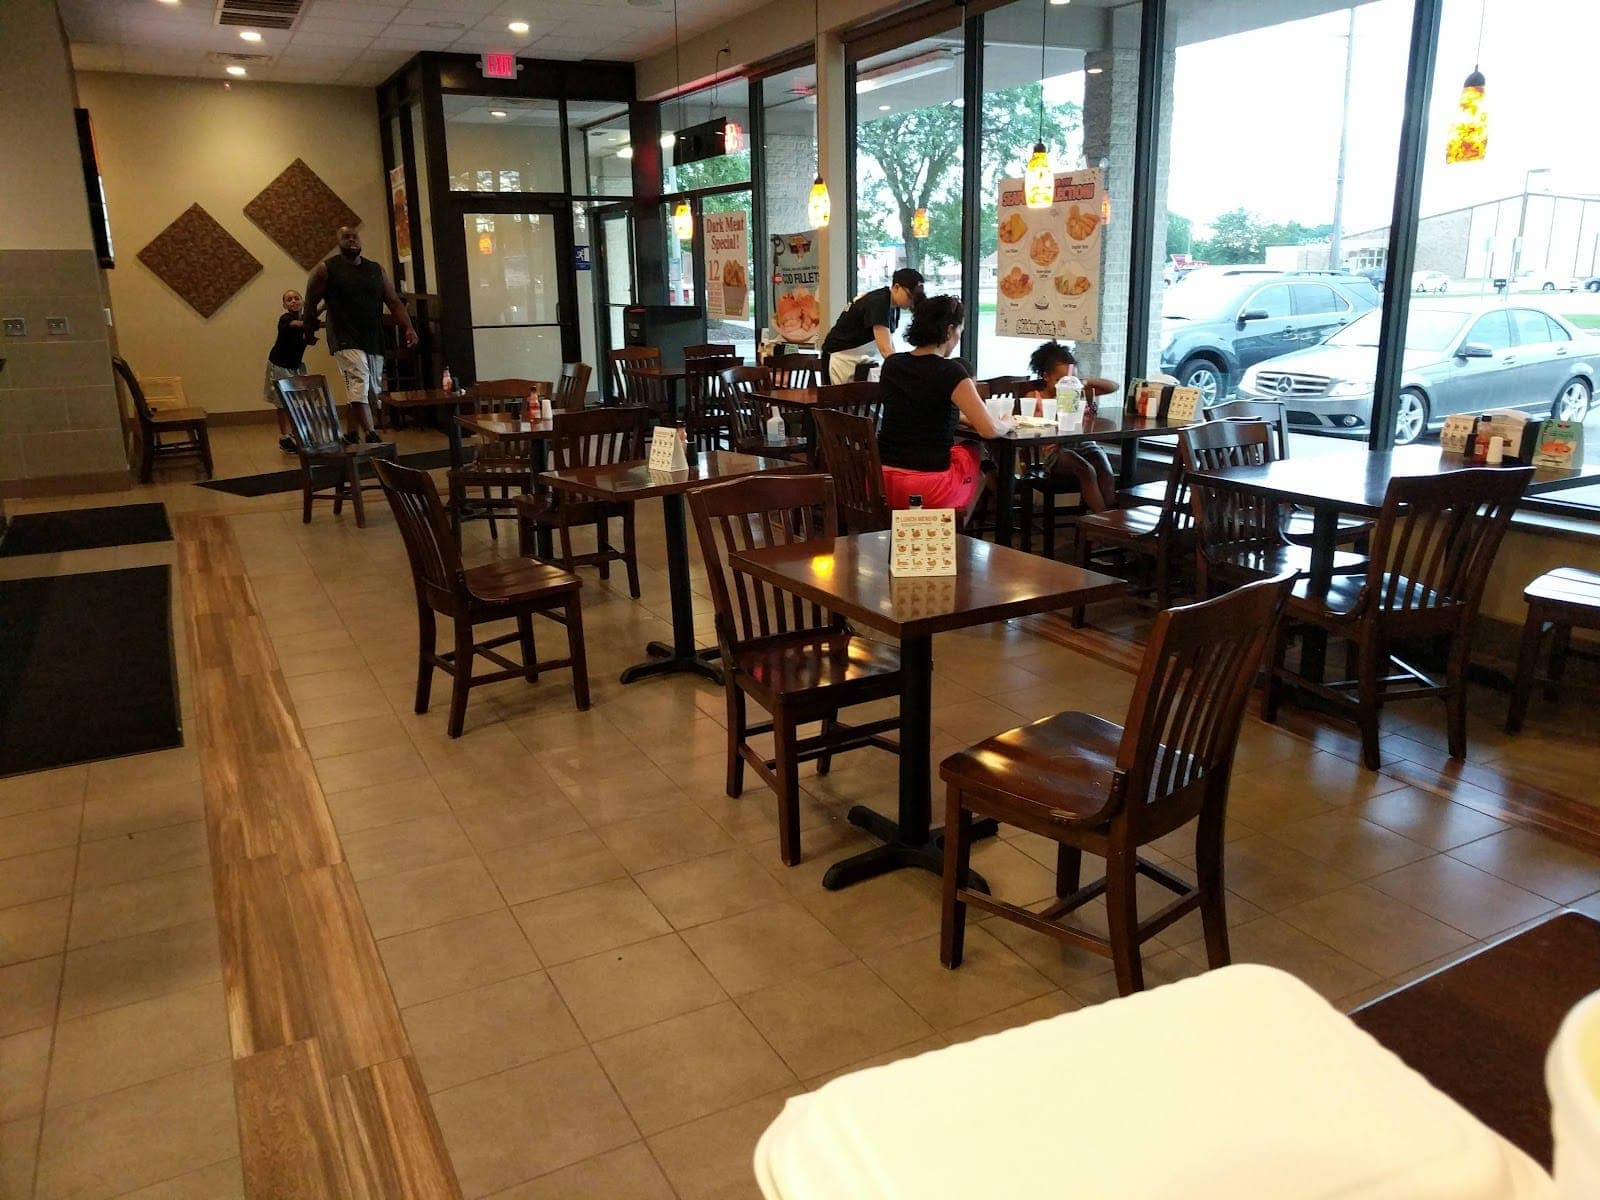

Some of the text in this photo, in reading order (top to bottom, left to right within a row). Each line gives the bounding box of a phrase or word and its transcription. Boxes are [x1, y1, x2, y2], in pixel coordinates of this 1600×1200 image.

[488, 55, 512, 75] EXIT
[706, 216, 744, 233] Dark Meat
[711, 234, 740, 254] Special!
[709, 260, 720, 281] 12
